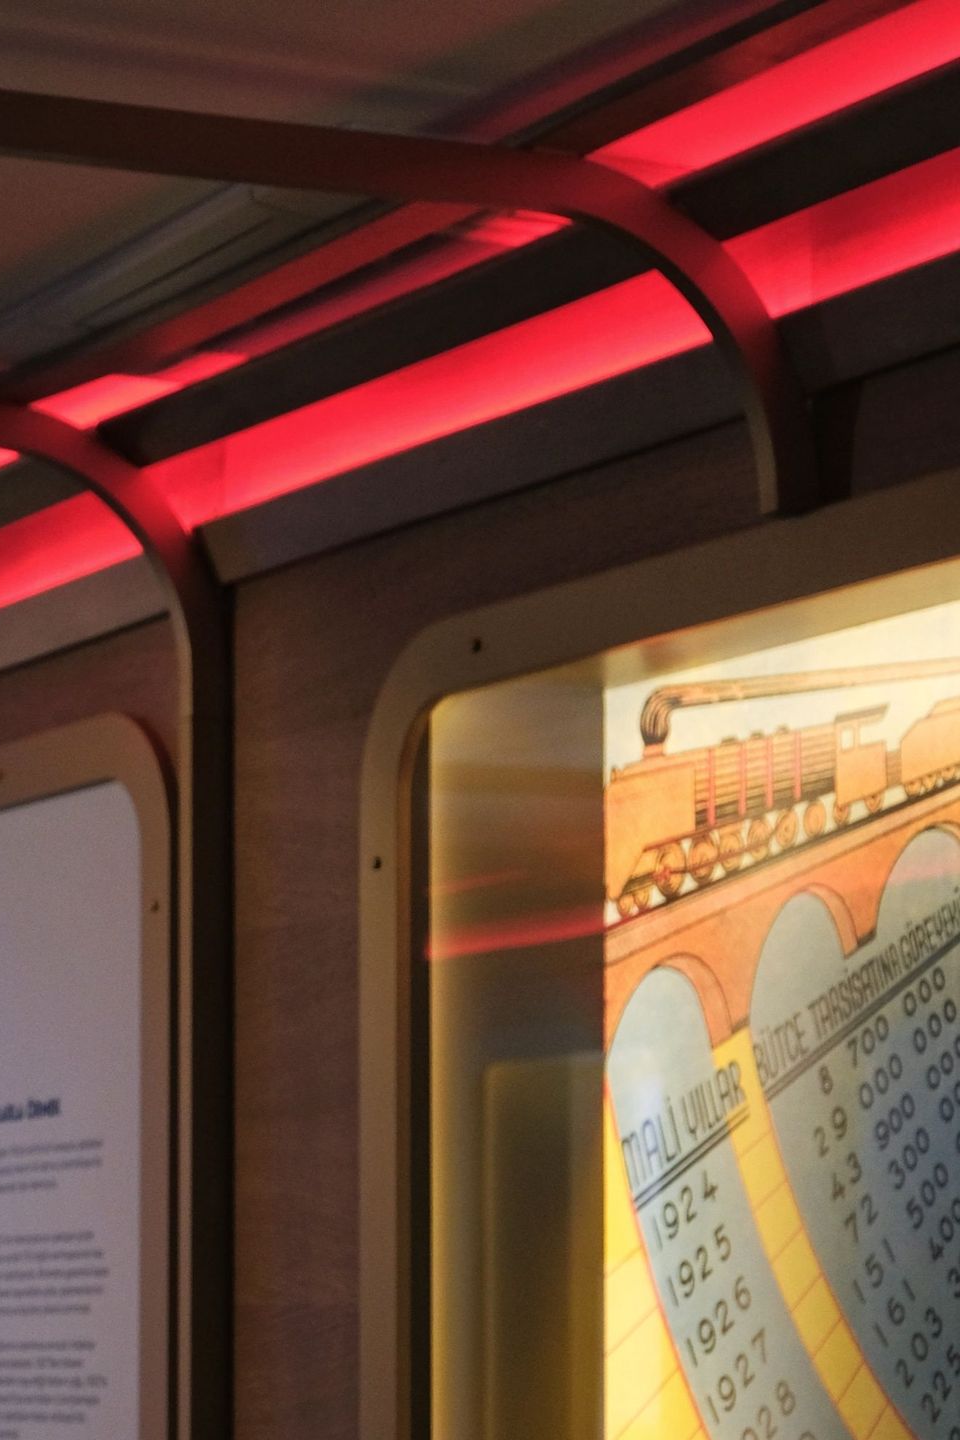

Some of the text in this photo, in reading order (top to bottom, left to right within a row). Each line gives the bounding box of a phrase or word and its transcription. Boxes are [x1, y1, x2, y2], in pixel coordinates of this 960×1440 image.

[653, 966, 946, 1250] 1924 8 700 000
[666, 997, 957, 1307] 1925 29 000 000
[685, 1060, 749, 1140] YILLAR
[685, 1275, 753, 1368] 1926
[831, 1151, 862, 1202] 43
[875, 1092, 916, 1150] 900
[705, 1327, 771, 1425] 1927
[844, 1193, 879, 1244] 72
[888, 1126, 931, 1191] 300
[852, 1237, 896, 1304] 151
[906, 1160, 949, 1231] 500
[872, 1277, 916, 1348] 161
[895, 1306, 943, 1389] 203
